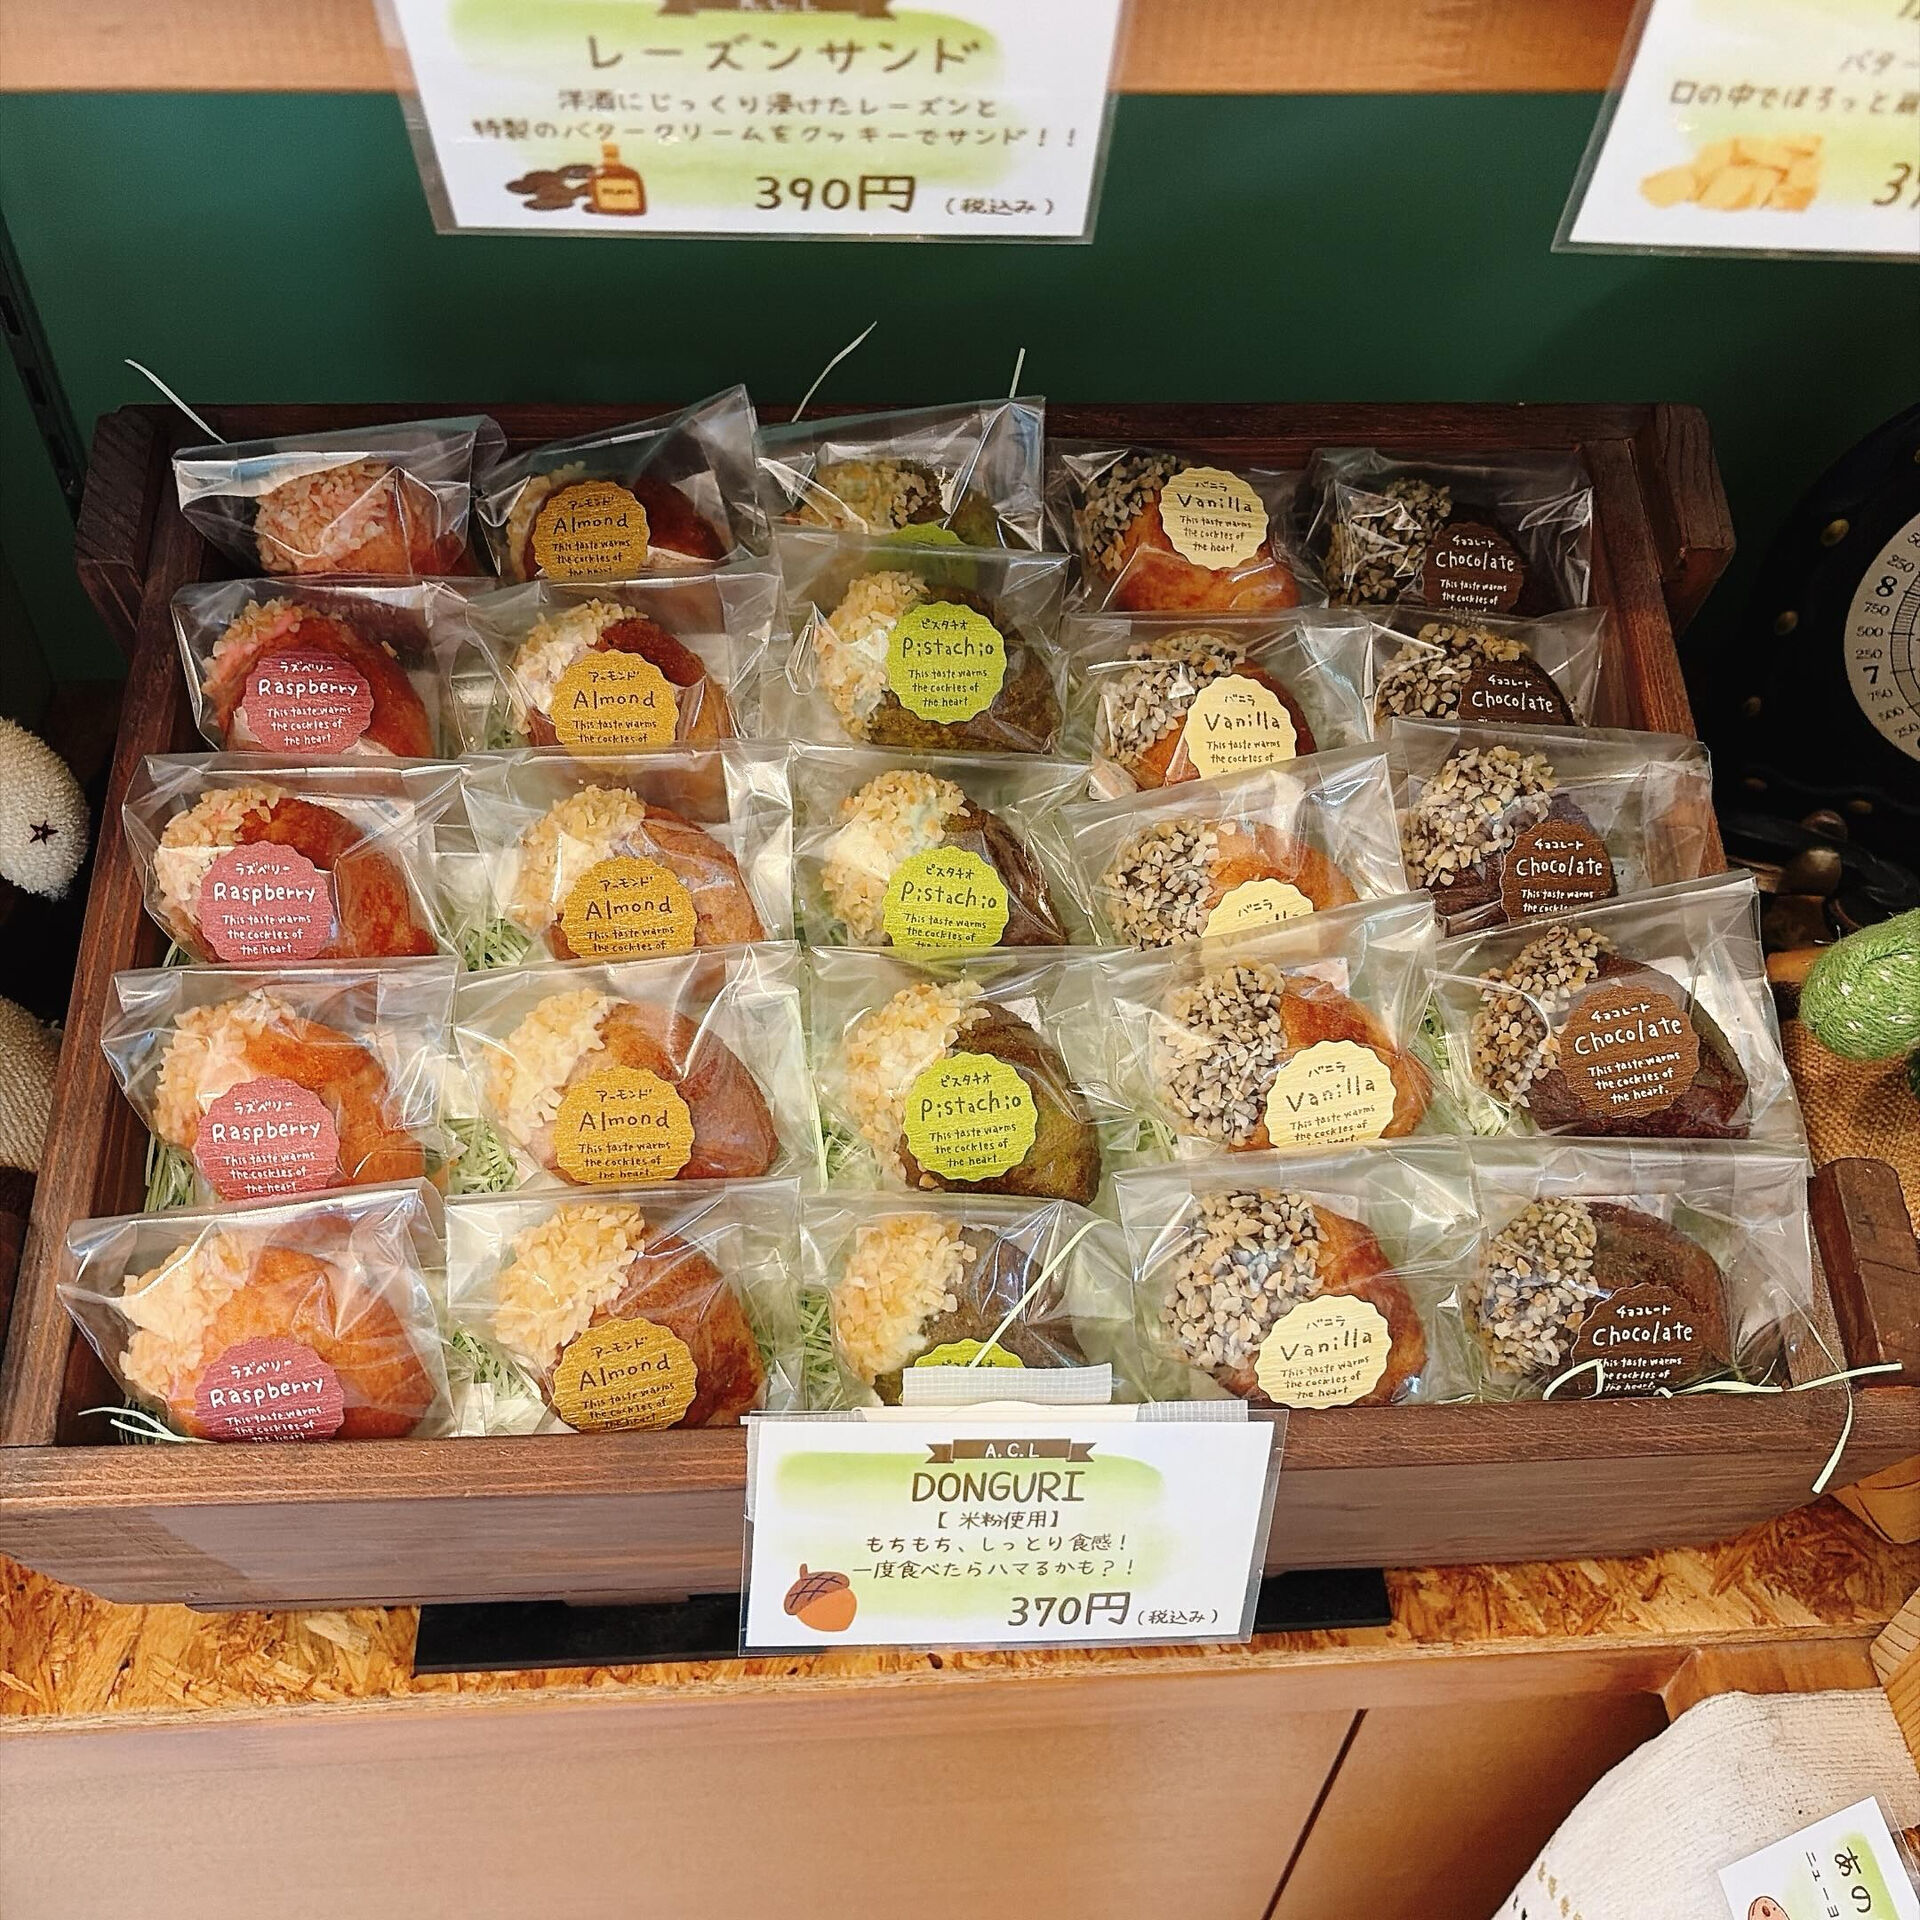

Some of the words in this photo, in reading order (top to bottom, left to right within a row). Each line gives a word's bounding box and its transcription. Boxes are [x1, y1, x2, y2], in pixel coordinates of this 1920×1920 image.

[587, 33, 981, 74] レーズンサンド
[755, 175, 916, 213] 390円
[1196, 482, 1227, 492] バニラ
[568, 496, 614, 510] アーモンド
[1177, 493, 1252, 512] Vanilla
[554, 513, 629, 534] Almond
[1452, 535, 1495, 548] チョコレート
[1436, 551, 1514, 572] Chocolate
[1875, 576, 1897, 597] 8
[1864, 602, 1890, 616] 750
[922, 618, 968, 630] ピスタチオ
[1856, 626, 1883, 637] 500
[902, 636, 994, 658] Pistachio
[280, 661, 334, 672] ラズベリー
[1863, 666, 1879, 684] 7
[588, 671, 640, 682] アーモンド
[1488, 675, 1532, 688] チョコレート
[258, 679, 358, 699] Raspberry
[574, 690, 655, 709] Almond
[1225, 694, 1255, 706] バニラ
[1472, 691, 1553, 713] Chocolate
[1204, 711, 1280, 731] Vanilla
[1534, 838, 1584, 850] チョコレート
[236, 861, 290, 875] ラズベリー
[926, 864, 974, 880] ピスタチオ
[1516, 856, 1602, 876] Chocolate
[600, 876, 653, 892] アーモンド
[214, 882, 315, 906] Raspberry
[901, 881, 997, 908] Pistachio
[586, 896, 672, 921] Almond
[1239, 899, 1272, 917] バニラ
[904, 912, 924, 923] This
[928, 915, 952, 926] taste
[956, 920, 986, 928] warms
[907, 927, 922, 936] the
[925, 930, 962, 940] cockles
[966, 933, 976, 942] of
[1591, 1003, 1651, 1023] チョコレート
[1575, 1017, 1682, 1055] Chocolate
[1308, 1062, 1346, 1077] バニラ
[1588, 1066, 1612, 1077] This
[1614, 1059, 1644, 1072] taste
[1644, 1052, 1680, 1065] warms
[941, 1072, 992, 1087] ピスタチオ
[1595, 1081, 1614, 1090] the
[1617, 1072, 1659, 1085] cockles
[1662, 1067, 1674, 1078] of
[596, 1089, 652, 1102] アーモンド
[1286, 1076, 1375, 1112] Vanilla
[1611, 1093, 1629, 1104] the
[234, 1100, 292, 1115] ラズベリー
[922, 1090, 1021, 1121] Pistachio
[580, 1110, 669, 1131] Almond
[212, 1121, 320, 1146] Raspberry
[929, 1132, 951, 1142] This
[954, 1128, 981, 1139] taste
[984, 1124, 1016, 1135] warms
[934, 1145, 951, 1154] the
[955, 1142, 994, 1152] cockles
[998, 1138, 1008, 1148] of
[947, 1158, 964, 1167] the
[1616, 1305, 1671, 1318] チョコレート
[1306, 1316, 1345, 1330] バニラ
[1592, 1321, 1693, 1346] Chocolate
[591, 1336, 648, 1359] アーモンド
[1281, 1328, 1372, 1361] Vanilla
[231, 1360, 292, 1379] ラズベリー
[580, 1354, 670, 1391] Almond
[210, 1378, 324, 1408] Raspberry
[985, 1442, 1040, 1458] A.C.L
[912, 1470, 1086, 1503] DONGURI
[866, 1532, 1126, 1554] もちもち、しっとり食感！
[1007, 1591, 1131, 1627] 370円
